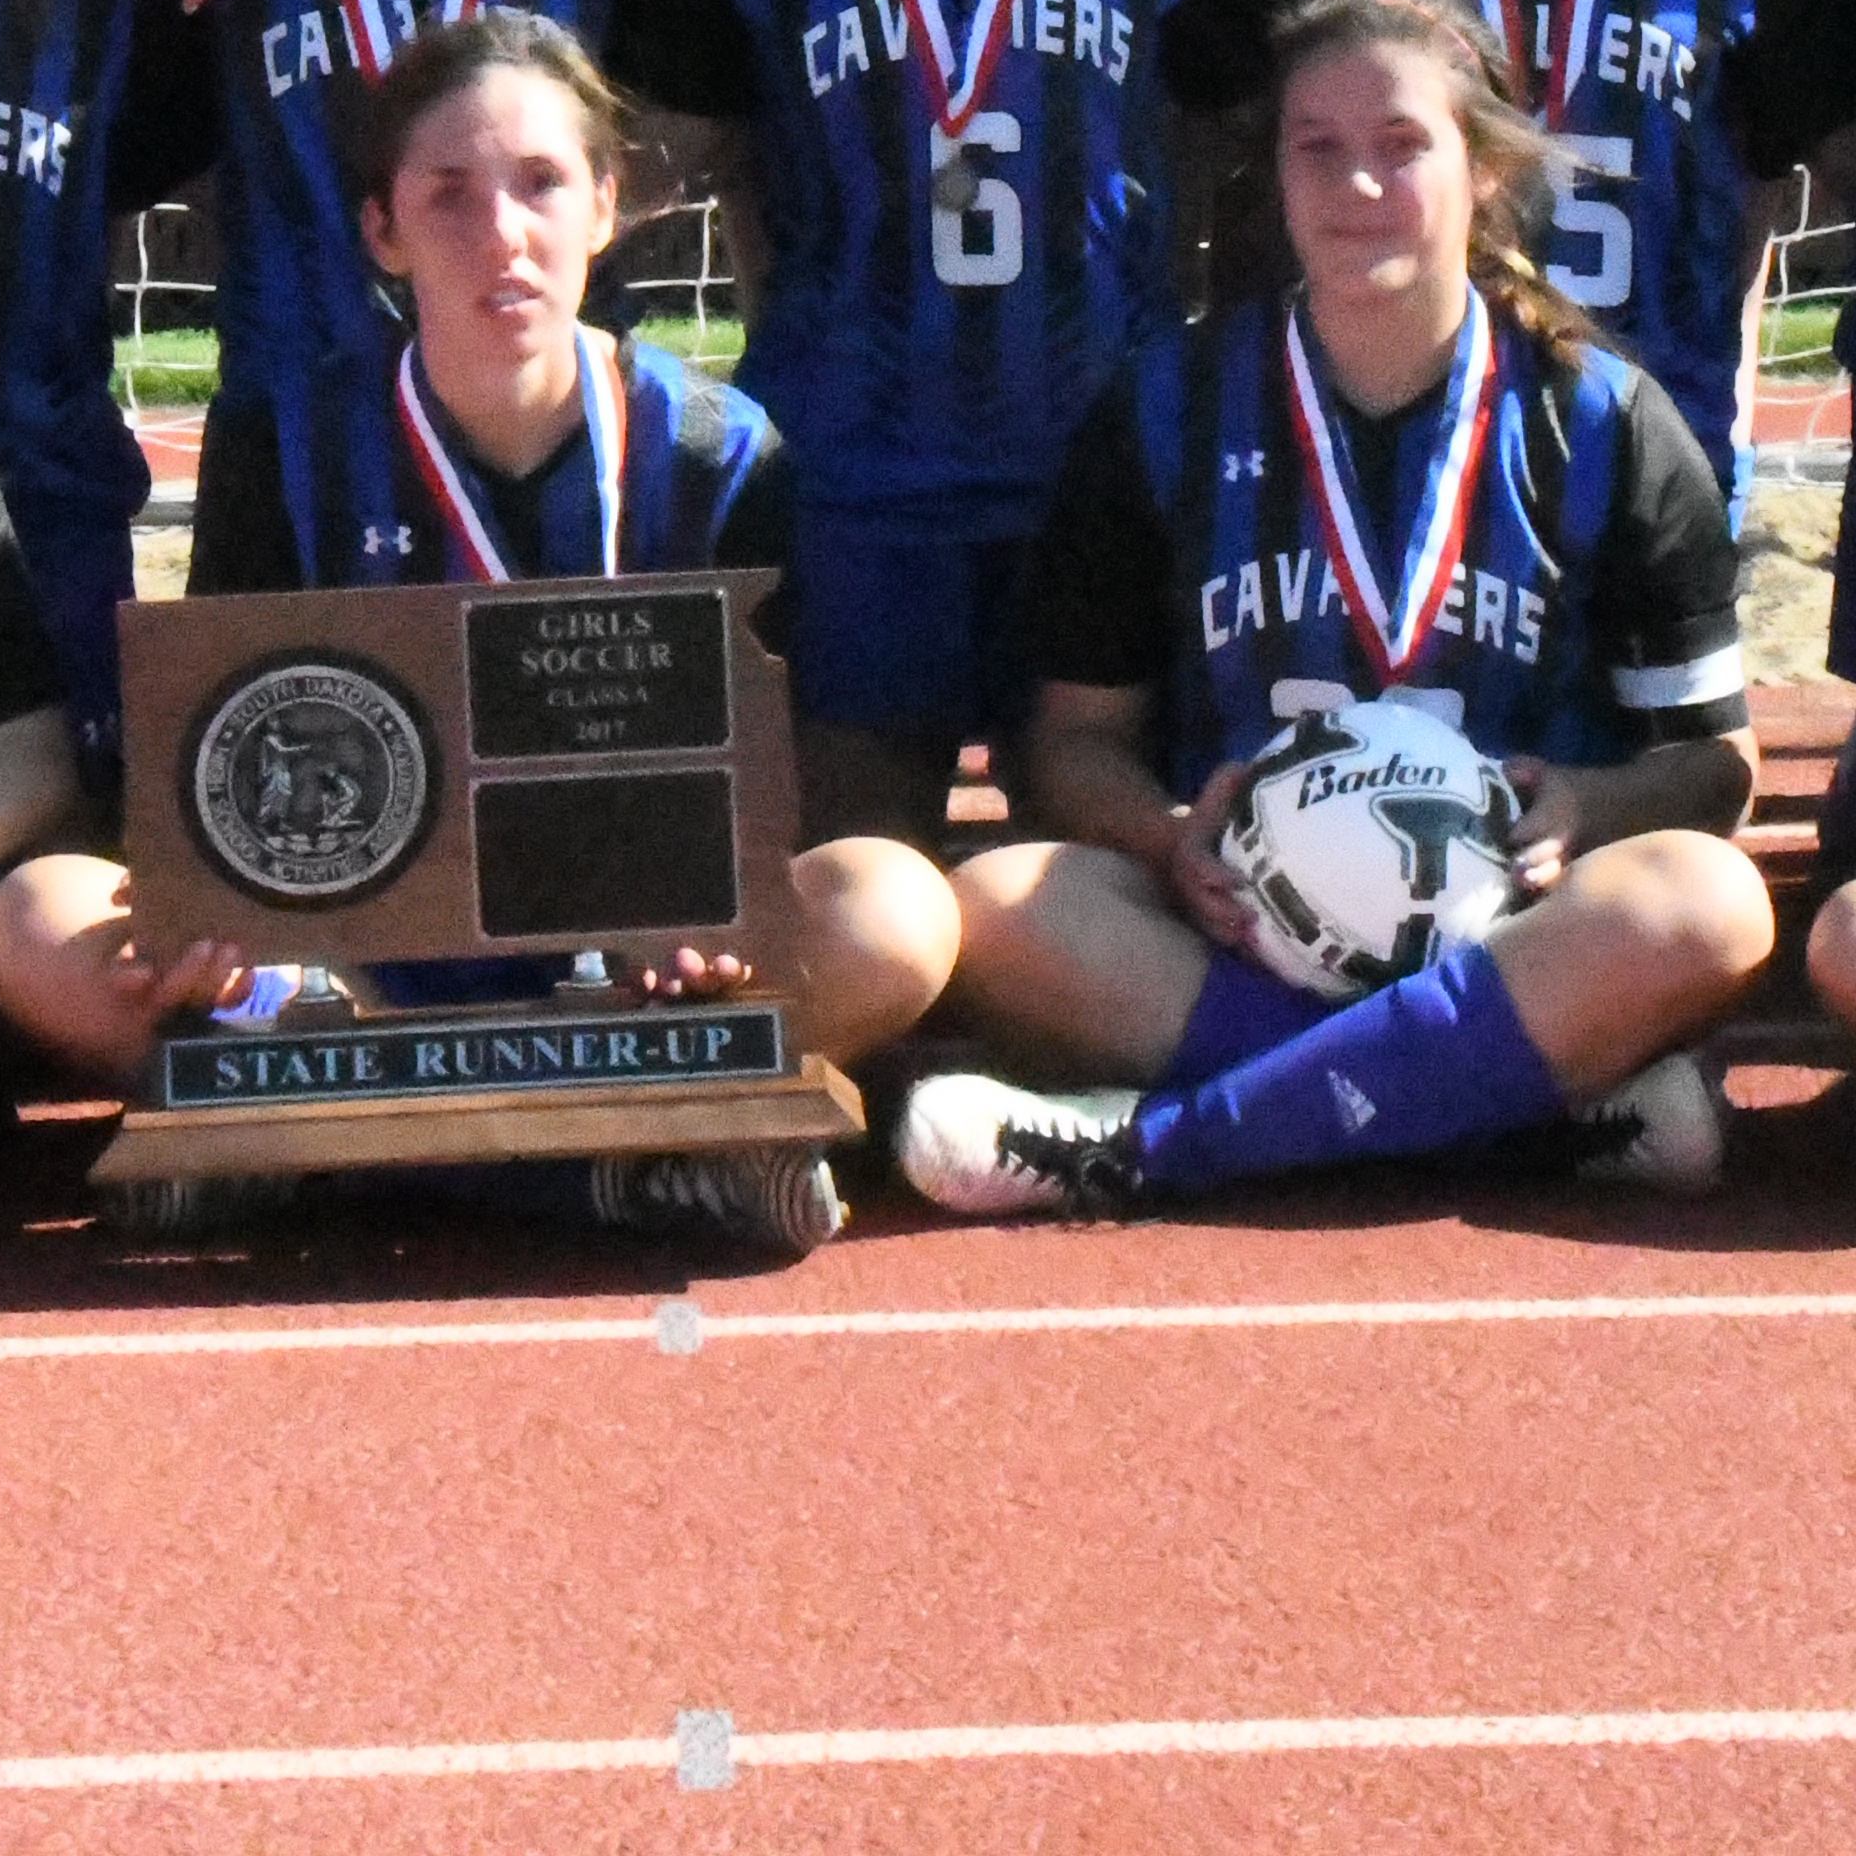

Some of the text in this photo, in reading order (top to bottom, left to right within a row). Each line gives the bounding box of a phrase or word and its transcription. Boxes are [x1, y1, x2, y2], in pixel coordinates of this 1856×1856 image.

[930, 111, 1024, 286] 6
[538, 609, 654, 640] GIRLS
[519, 642, 674, 675] SOCCER
[1297, 753, 1447, 811] Baden
[214, 1027, 735, 1091] STATE RUNNER-UP
